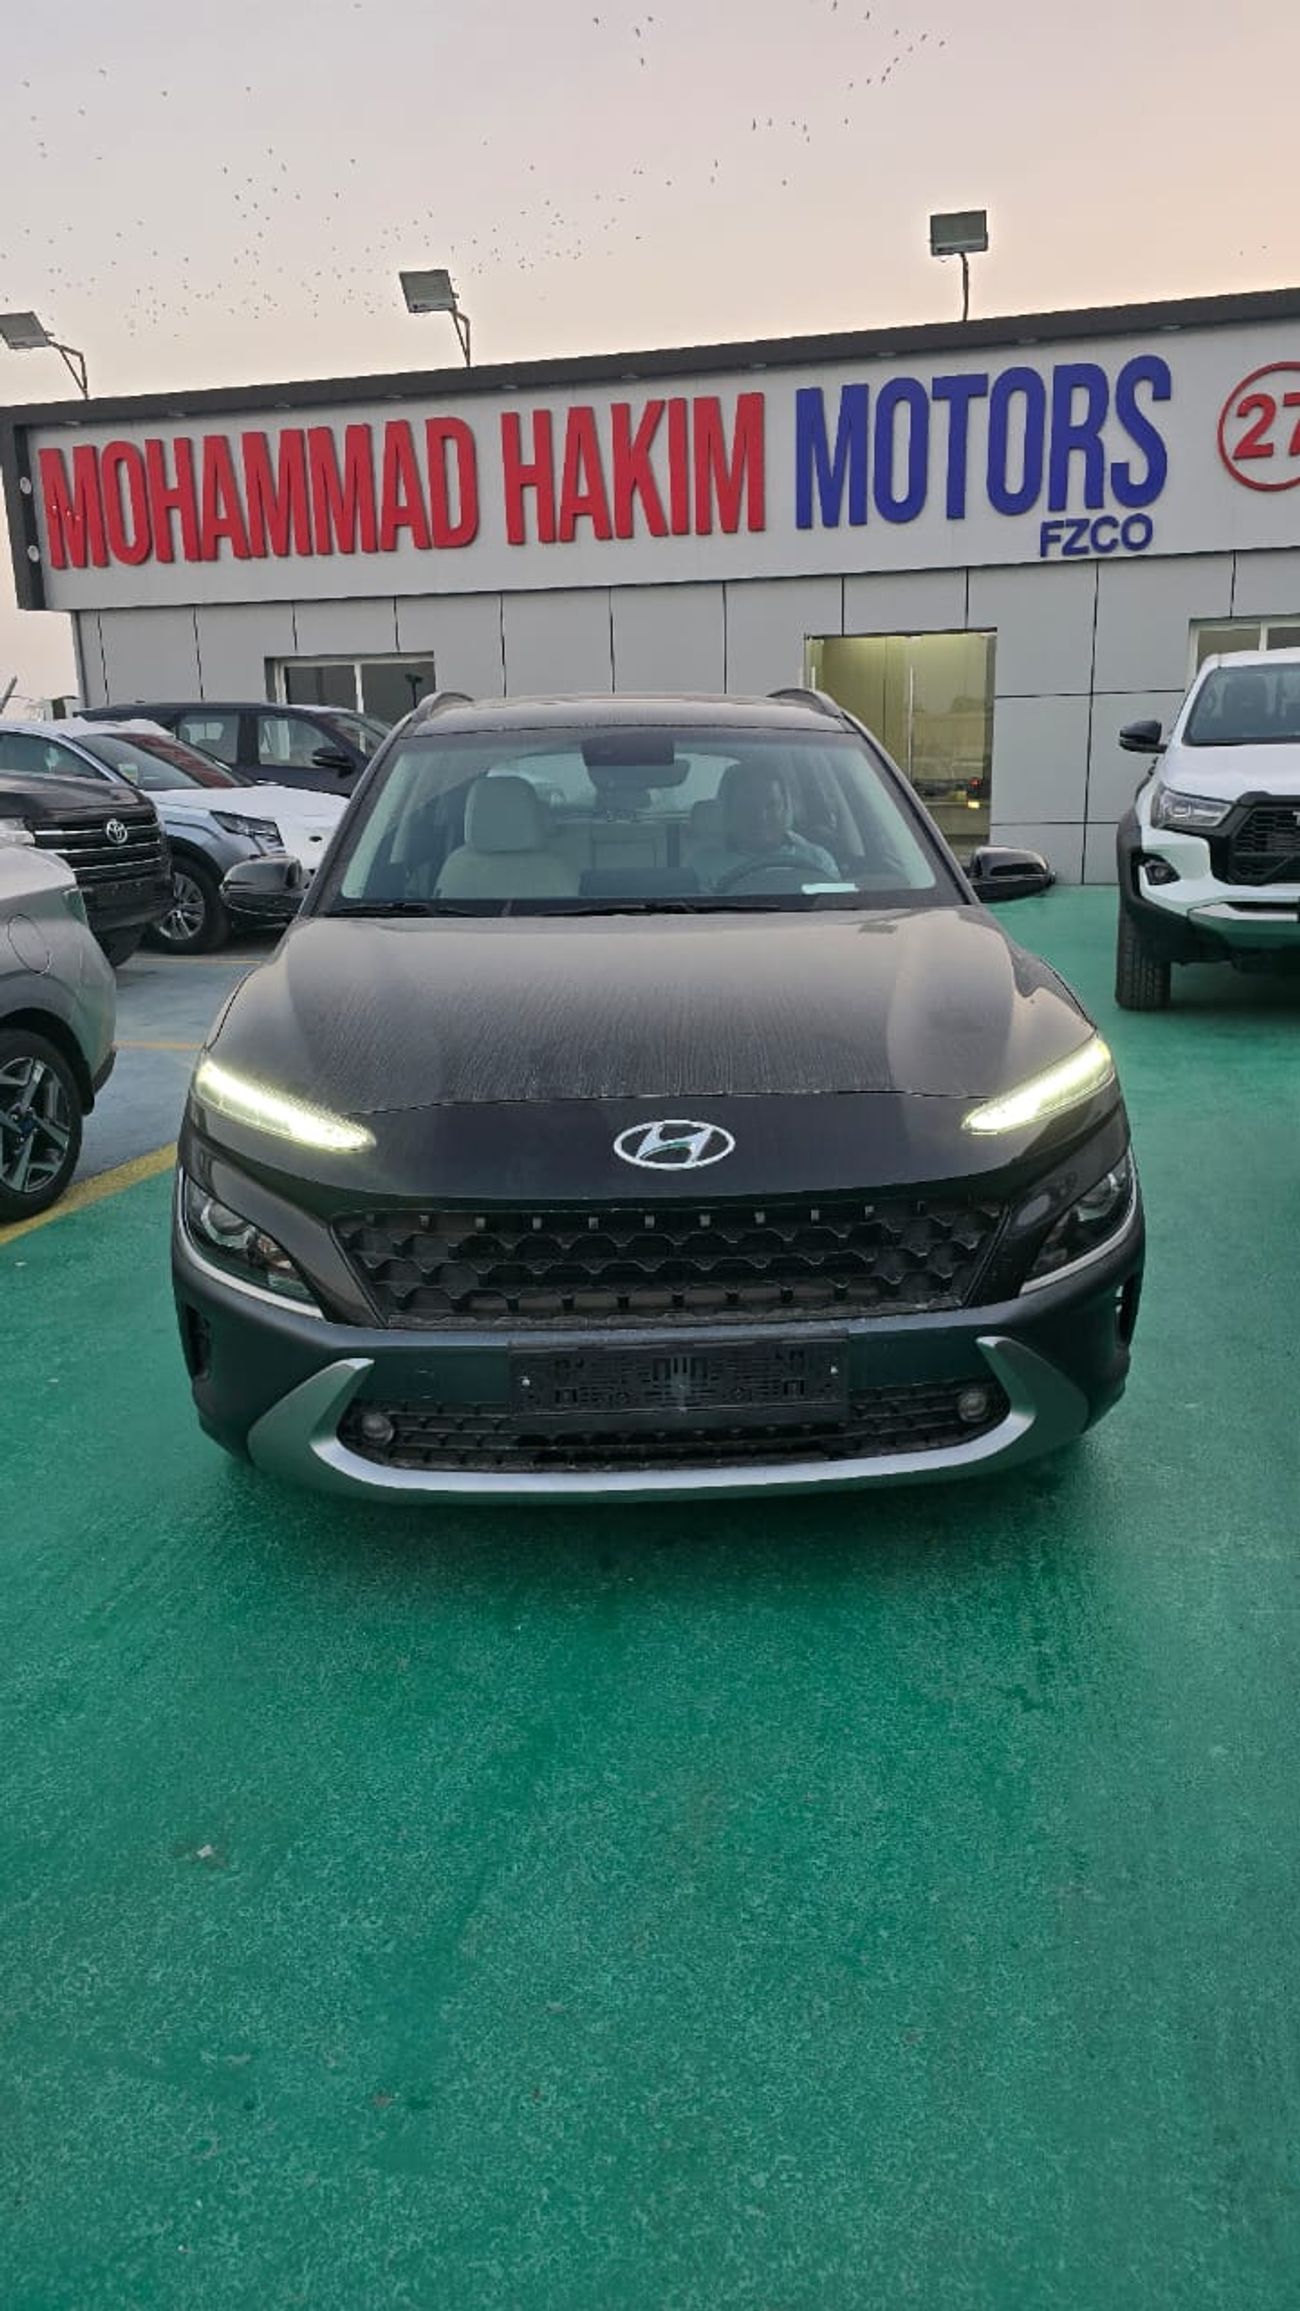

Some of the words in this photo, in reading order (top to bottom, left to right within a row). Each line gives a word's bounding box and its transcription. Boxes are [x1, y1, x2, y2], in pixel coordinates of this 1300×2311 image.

[38, 416, 480, 570] MOHAMMAD
[501, 392, 766, 545] HAKIM
[795, 354, 1172, 530] MOTORS
[1039, 512, 1154, 558] FZCO
